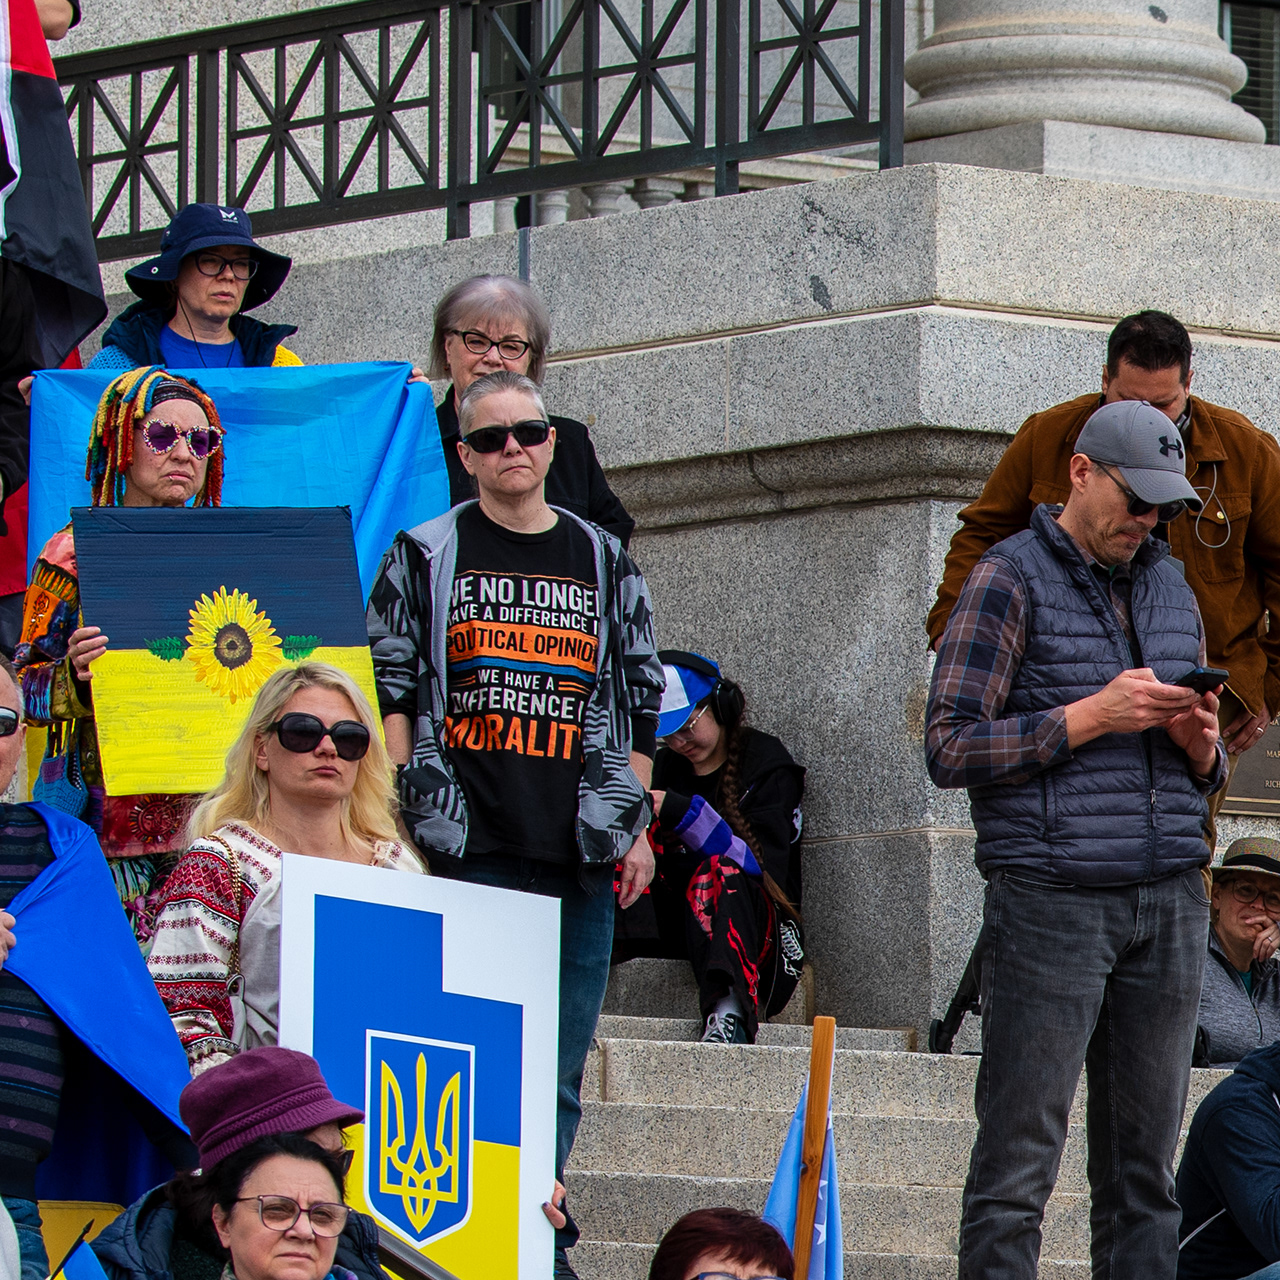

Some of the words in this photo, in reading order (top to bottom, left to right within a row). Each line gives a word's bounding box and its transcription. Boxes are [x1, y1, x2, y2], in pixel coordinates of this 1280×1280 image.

[480, 577, 515, 604] NO
[483, 606, 494, 621] A
[500, 607, 588, 633] DIFFERENCE
[478, 669, 500, 684] WE
[505, 672, 541, 690] HAVE
[547, 677, 555, 691] A
[451, 687, 576, 719] DIFFERENCE
[444, 714, 584, 763] MORALIT
